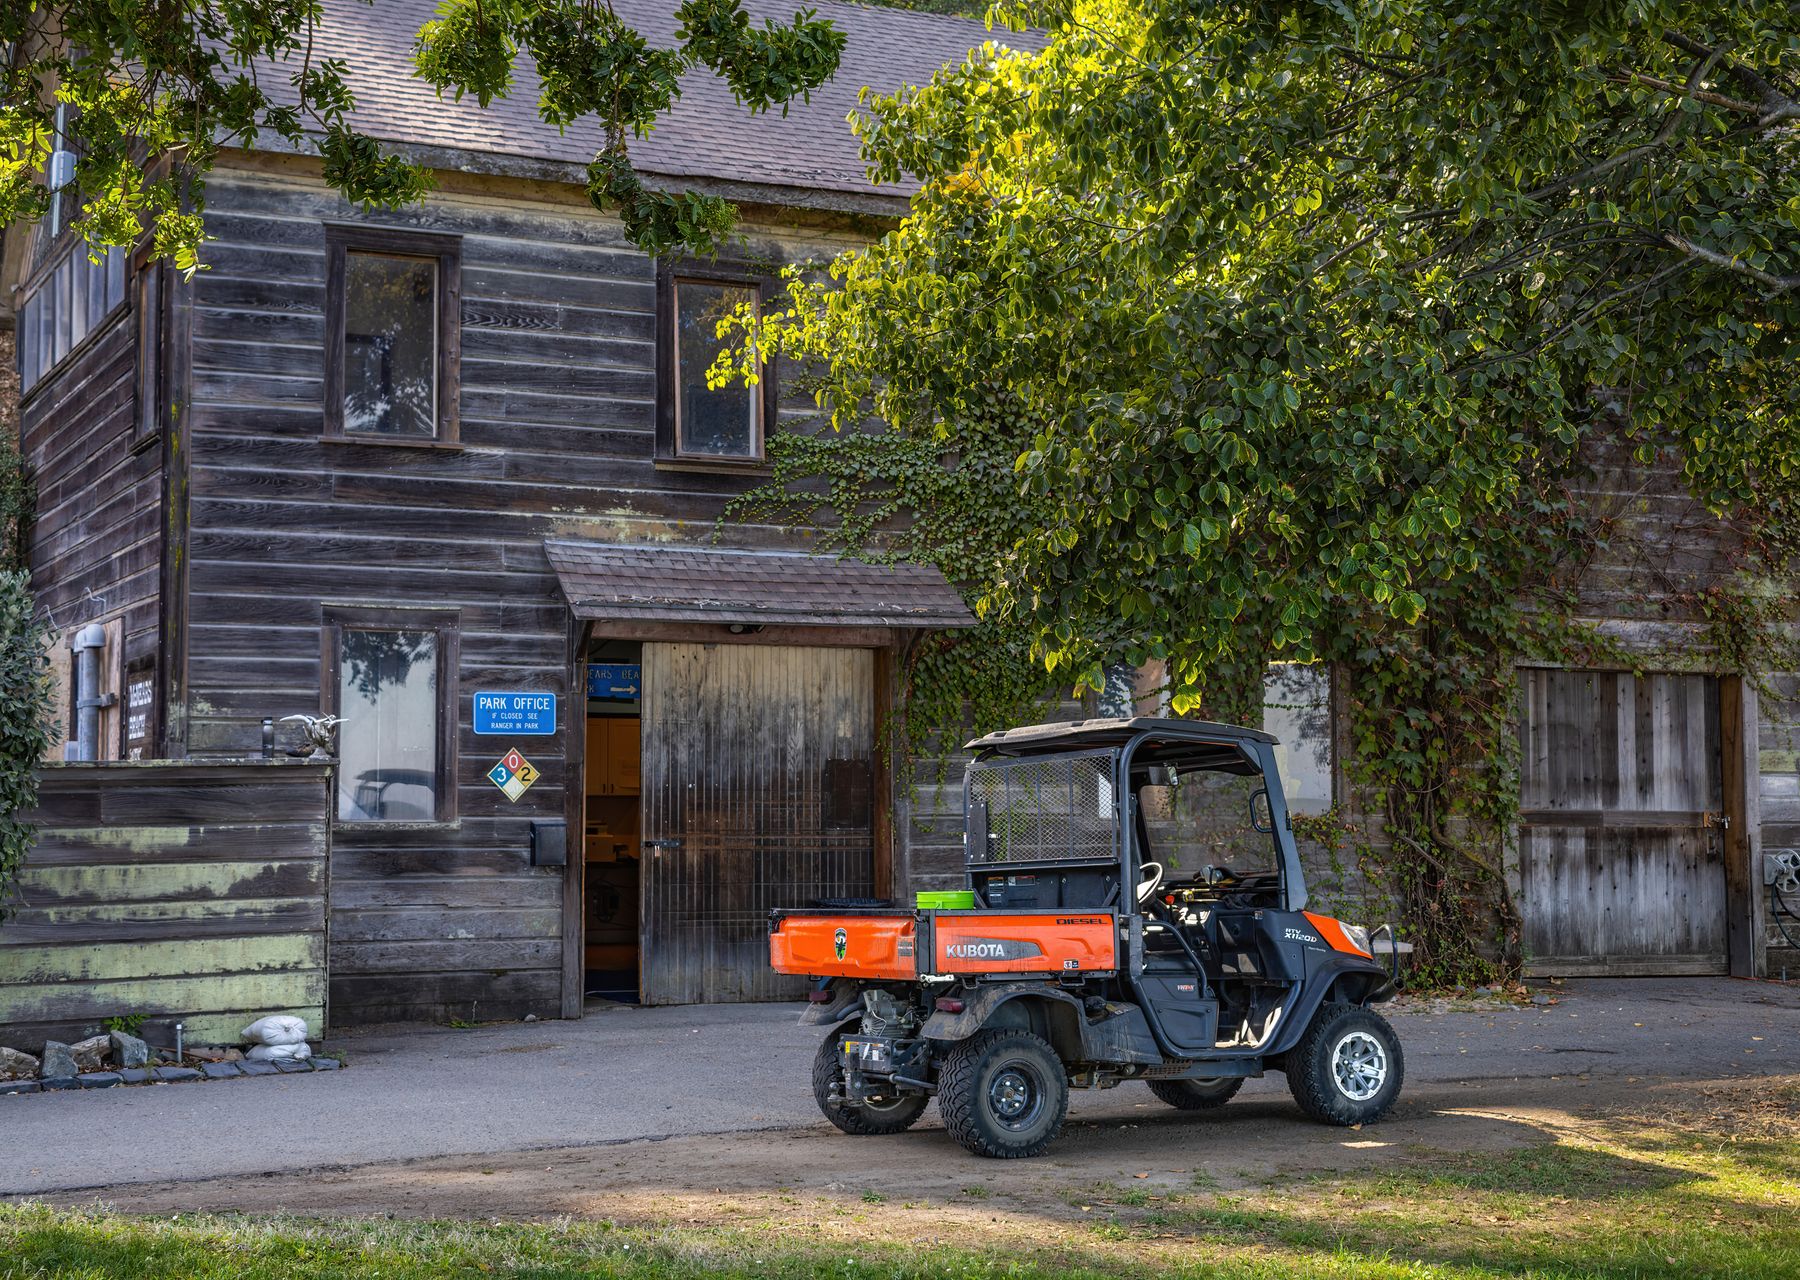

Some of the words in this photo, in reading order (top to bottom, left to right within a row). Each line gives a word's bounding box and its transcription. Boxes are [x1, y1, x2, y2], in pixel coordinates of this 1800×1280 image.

[479, 697, 507, 710] PARK
[513, 697, 550, 710] OFFICE
[500, 712, 523, 720] CLOSED
[508, 754, 519, 769] 0
[497, 767, 507, 782] 3
[520, 767, 531, 782] 2
[946, 943, 1005, 958] KUBOTA
